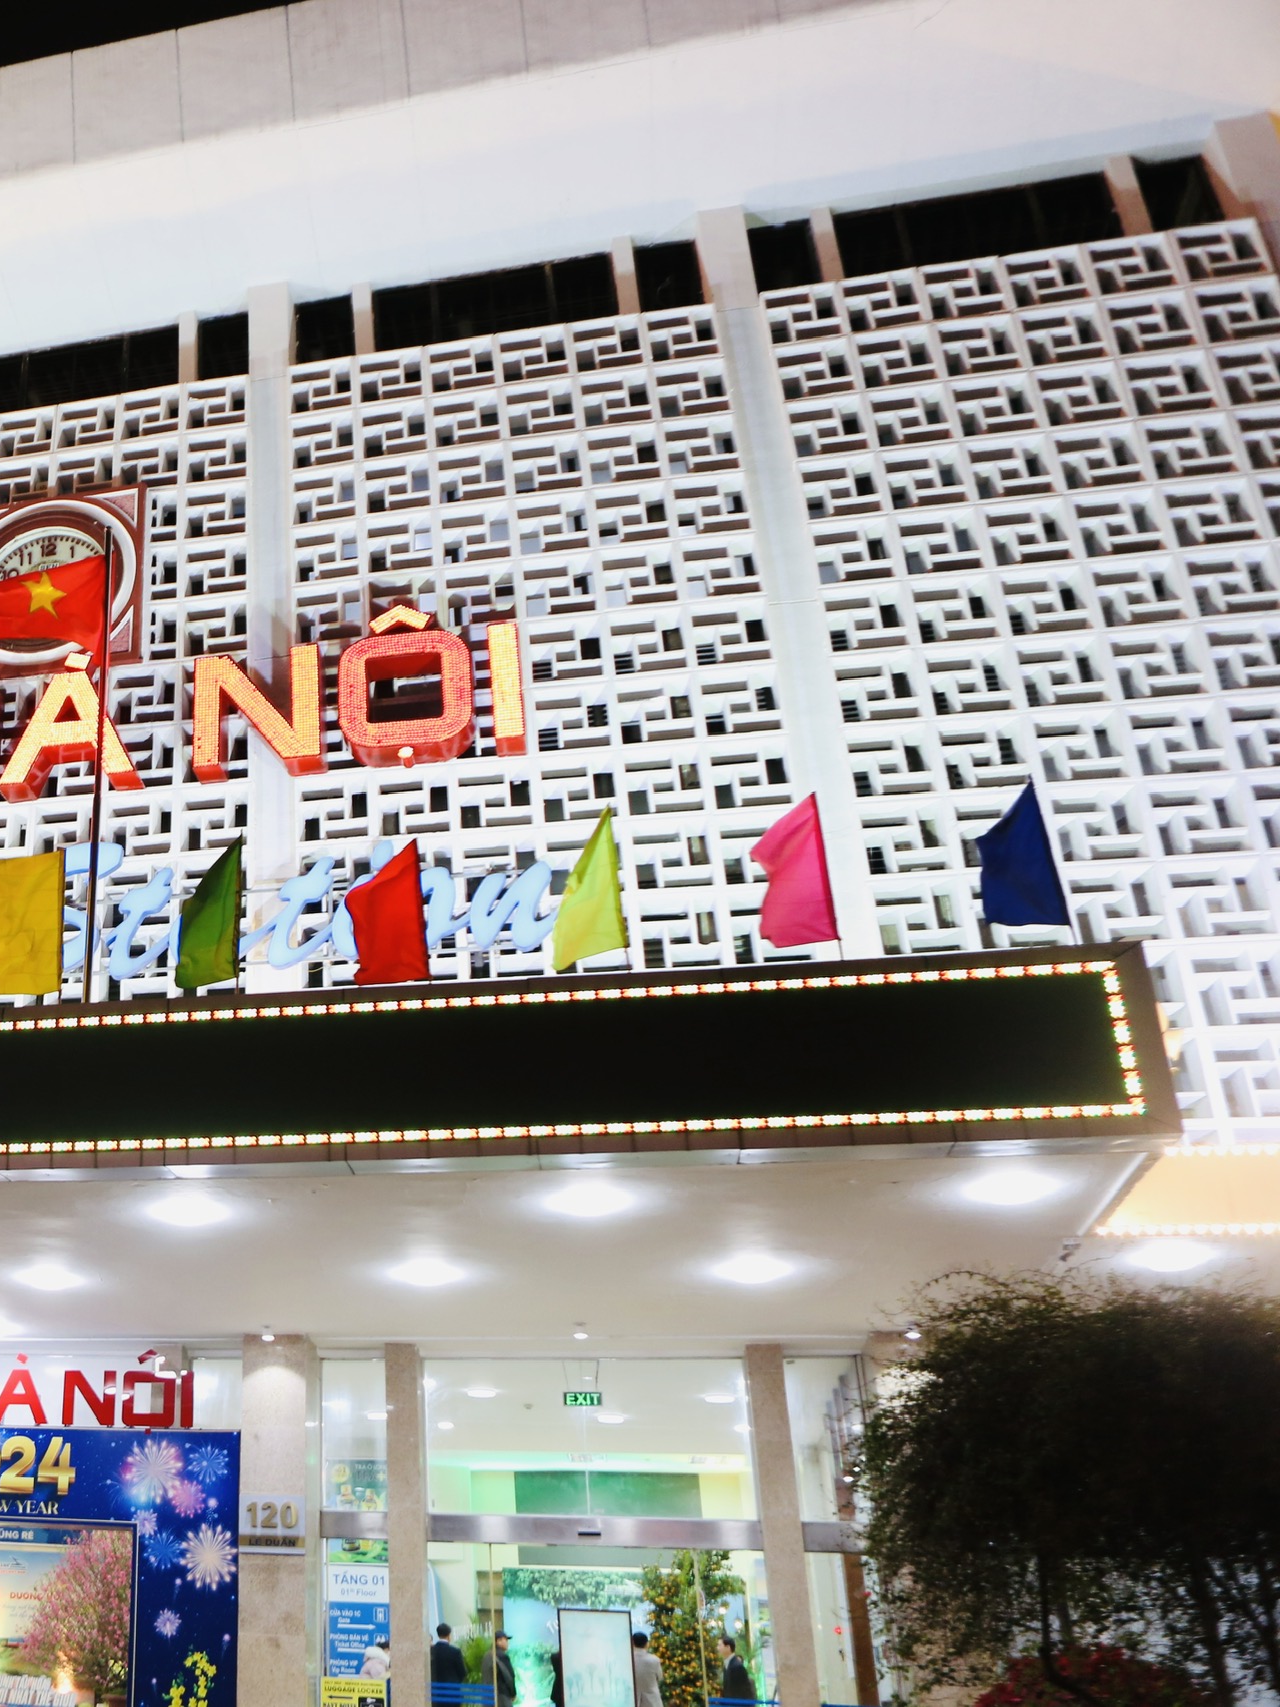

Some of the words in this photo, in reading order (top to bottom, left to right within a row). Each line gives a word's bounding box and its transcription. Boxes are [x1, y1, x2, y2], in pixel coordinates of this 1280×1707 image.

[40, 543, 57, 557] 12
[69, 545, 75, 558] 1
[19, 552, 32, 566] 11
[192, 604, 527, 784] NỘI
[61, 1348, 195, 1435] NỘI
[566, 1393, 601, 1406] EXIT
[16, 1500, 59, 1515] YEAR
[246, 1501, 299, 1529] 120
[372, 1574, 385, 1586] 01
[356, 1588, 377, 1597] Floor
[324, 1685, 355, 1693] LUGGAGE
